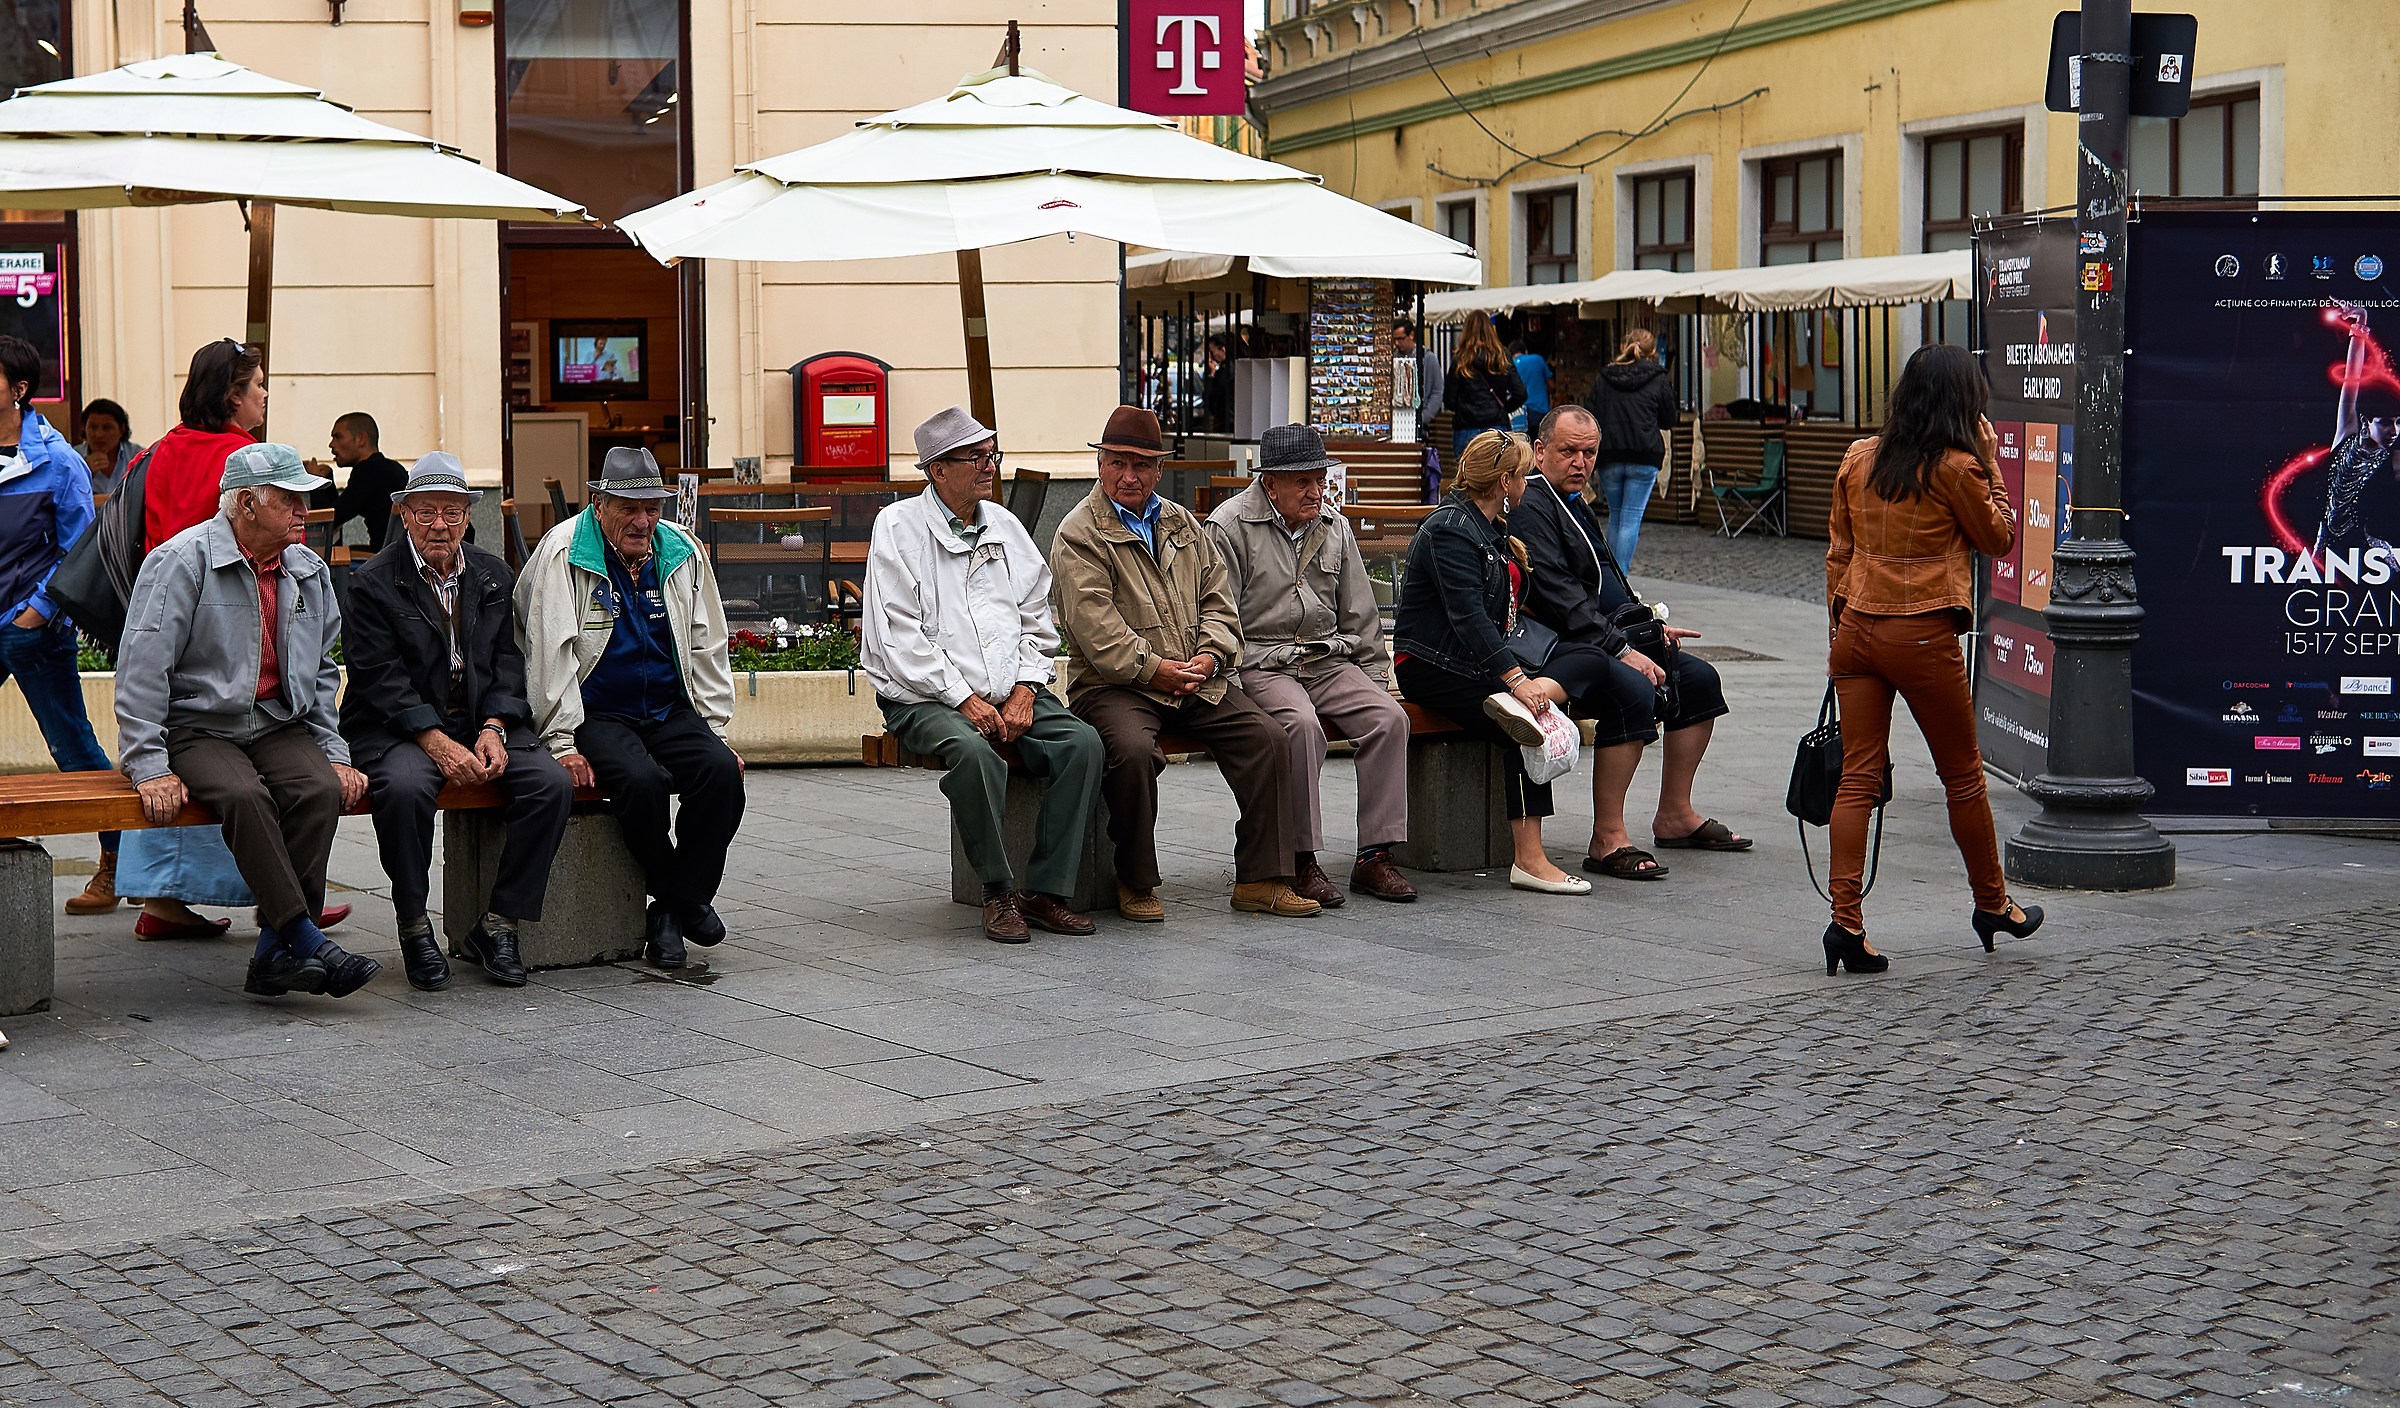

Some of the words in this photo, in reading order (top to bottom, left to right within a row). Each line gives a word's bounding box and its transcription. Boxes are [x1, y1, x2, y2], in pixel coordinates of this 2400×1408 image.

[1156, 15, 1220, 94] T
[16, 275, 38, 308] 5
[2319, 299, 2331, 308] DE
[2332, 299, 2379, 308] CONSILIUL
[2006, 344, 2027, 365] BILETE
[2023, 377, 2043, 398] EARLY
[2044, 377, 2061, 399] BIRD
[2285, 632, 2337, 654] 15-17
[2363, 684, 2388, 692] DANCE
[2317, 710, 2348, 719] Walter
[2359, 711, 2374, 720] SEE
[2189, 773, 2207, 781] Sibiu
[2308, 773, 2343, 783] Tribuna
